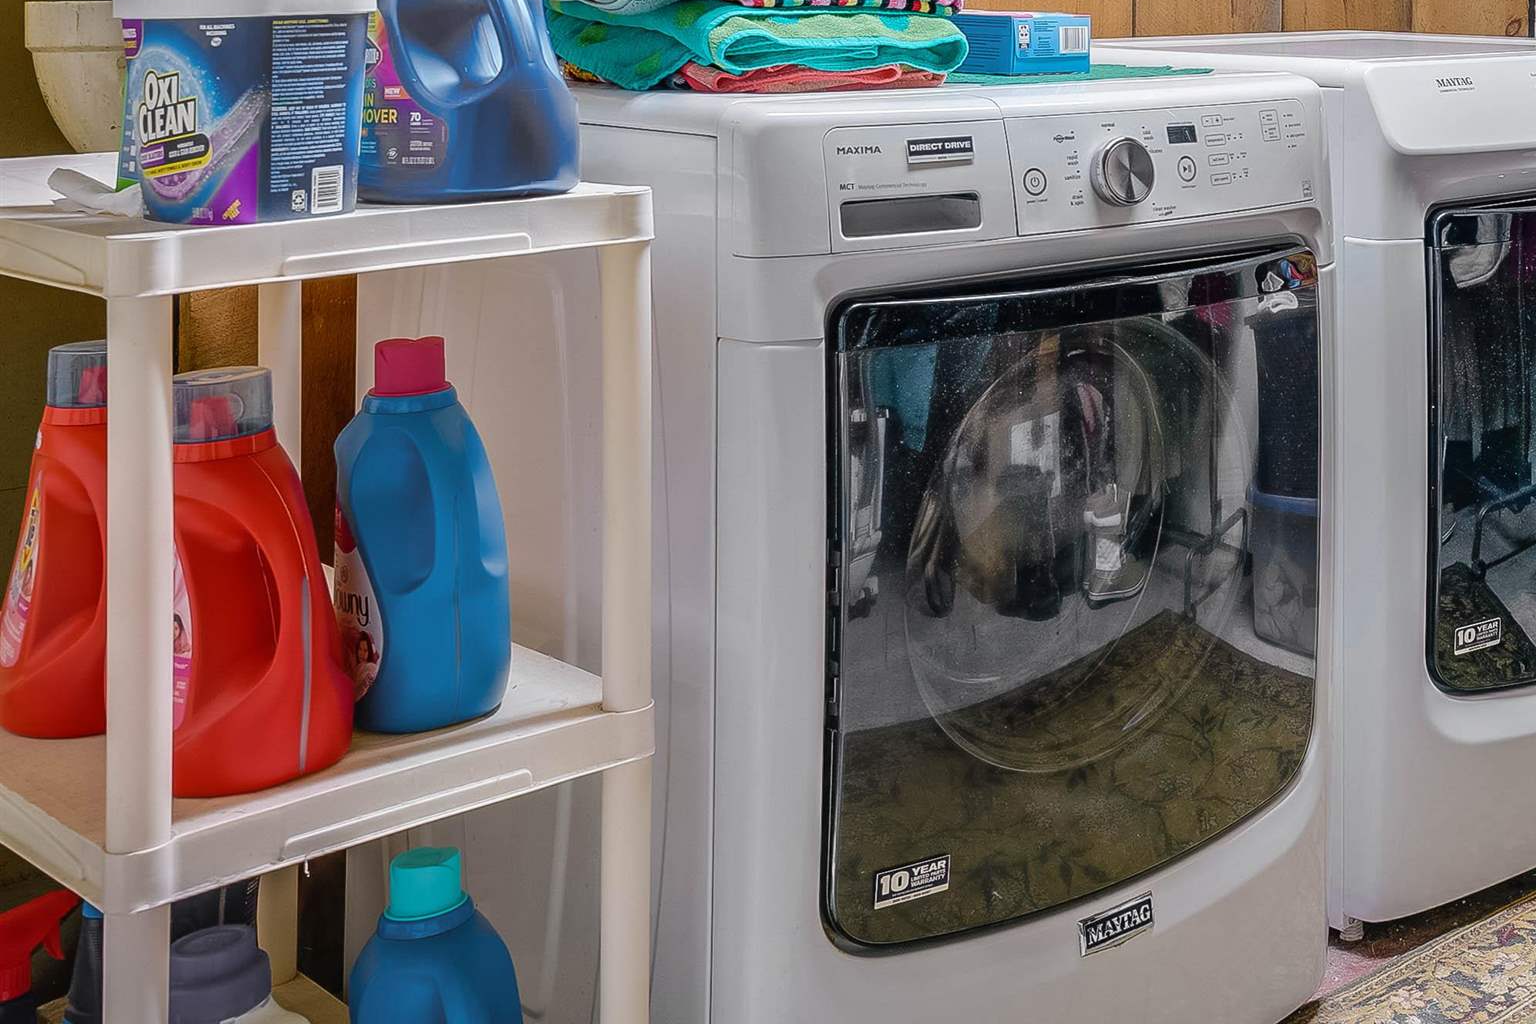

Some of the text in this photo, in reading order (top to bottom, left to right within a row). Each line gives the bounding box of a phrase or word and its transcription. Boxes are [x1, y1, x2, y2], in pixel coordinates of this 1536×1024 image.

[1435, 76, 1474, 88] MAYTAG
[144, 71, 179, 111] OXI
[138, 100, 196, 144] CLEAN
[409, 111, 422, 123] 70
[836, 145, 882, 156] MAXIMA
[909, 140, 971, 152] DIRECT DRIVE
[839, 183, 855, 191] MCT
[1457, 627, 1476, 646] 10
[1476, 621, 1498, 632] YEAR
[880, 870, 910, 896] 10
[911, 859, 947, 876] YEAR
[910, 874, 946, 888] WARRANTY
[1086, 903, 1152, 947] MAYTAG
